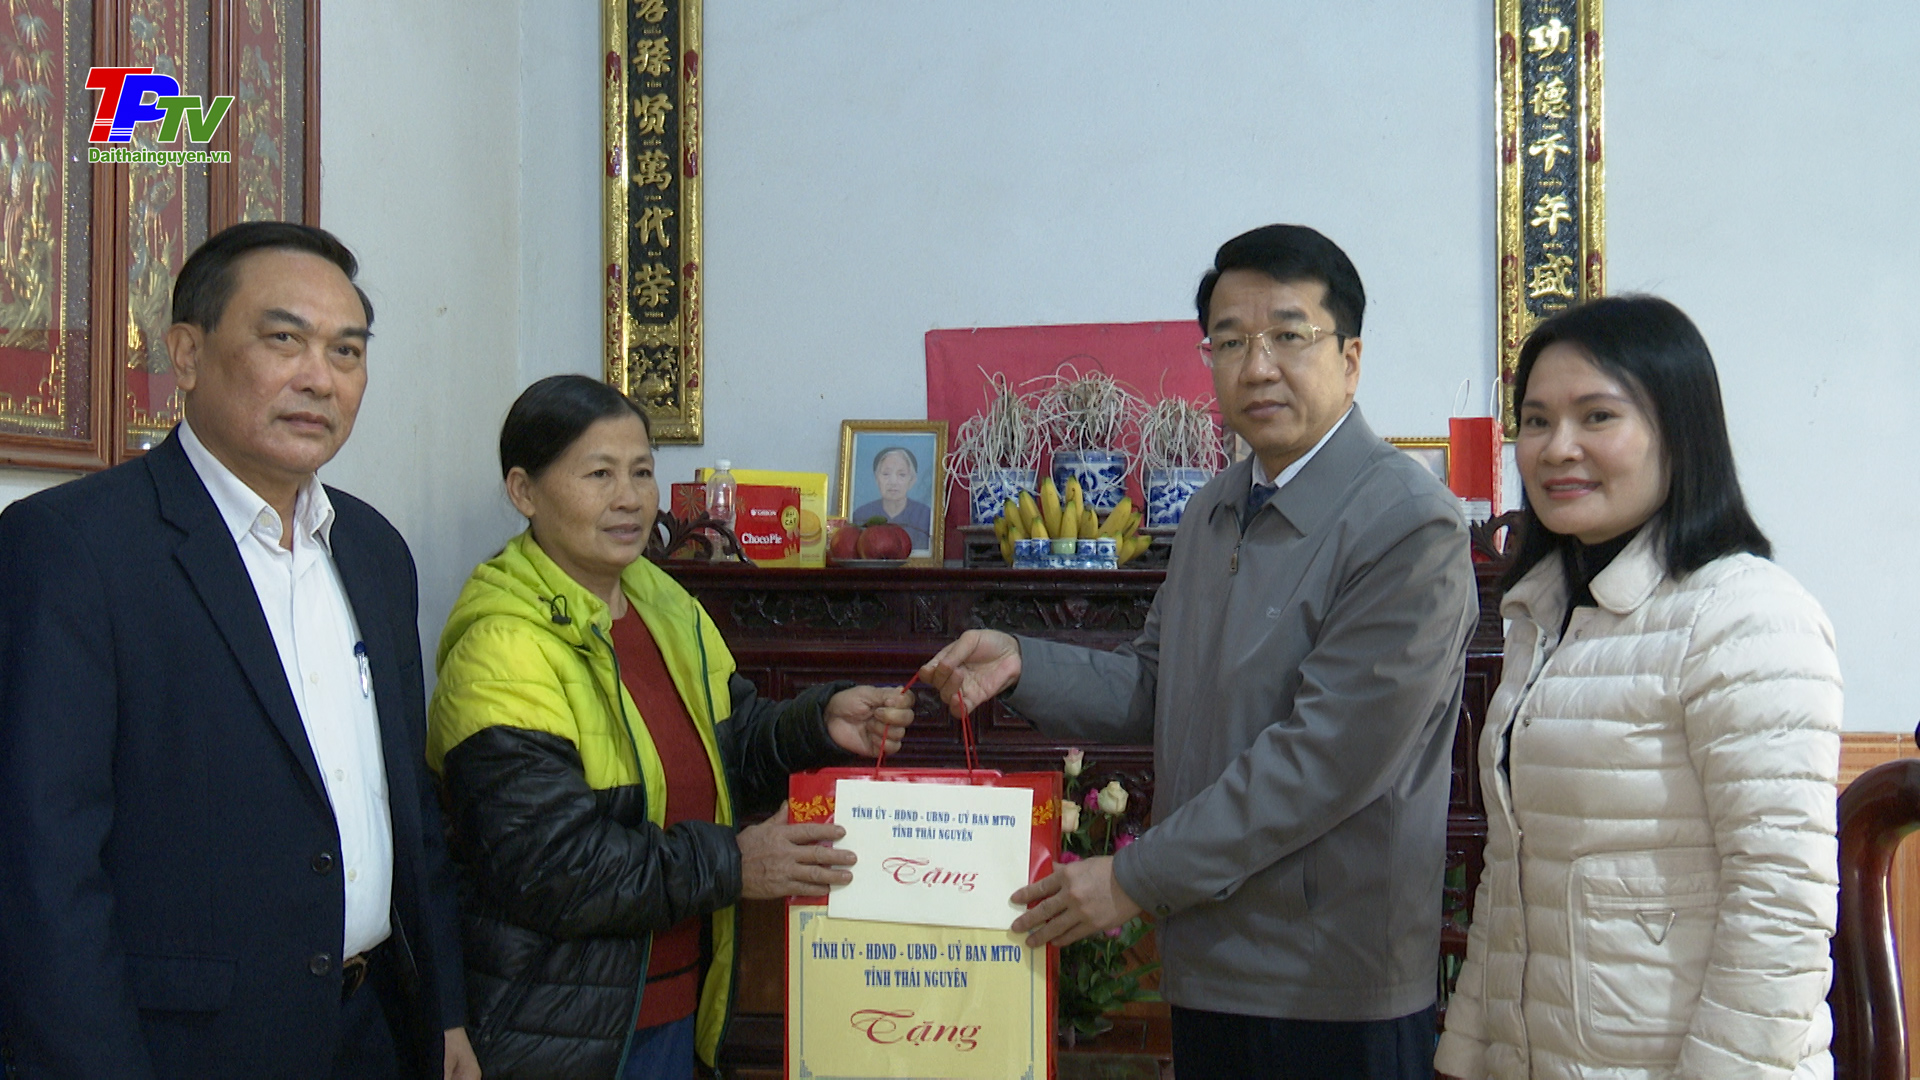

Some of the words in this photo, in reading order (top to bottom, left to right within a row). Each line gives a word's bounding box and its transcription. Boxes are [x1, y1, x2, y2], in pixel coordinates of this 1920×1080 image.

[926, 811, 950, 824] UBND
[972, 812, 990, 826] BAN
[992, 814, 1016, 828] MTTQ
[915, 826, 937, 840] THÁI
[938, 827, 973, 842] NGUYÊN
[882, 857, 978, 892] Tặng
[812, 938, 838, 960] TỈNH
[907, 944, 938, 962] UBND
[965, 944, 988, 962] BAN
[992, 945, 1022, 963] MTTQ
[864, 965, 892, 988] TỈNH
[895, 967, 922, 988] THÁI
[924, 967, 968, 988] NGUYÊN
[850, 1009, 982, 1051] Tặng
